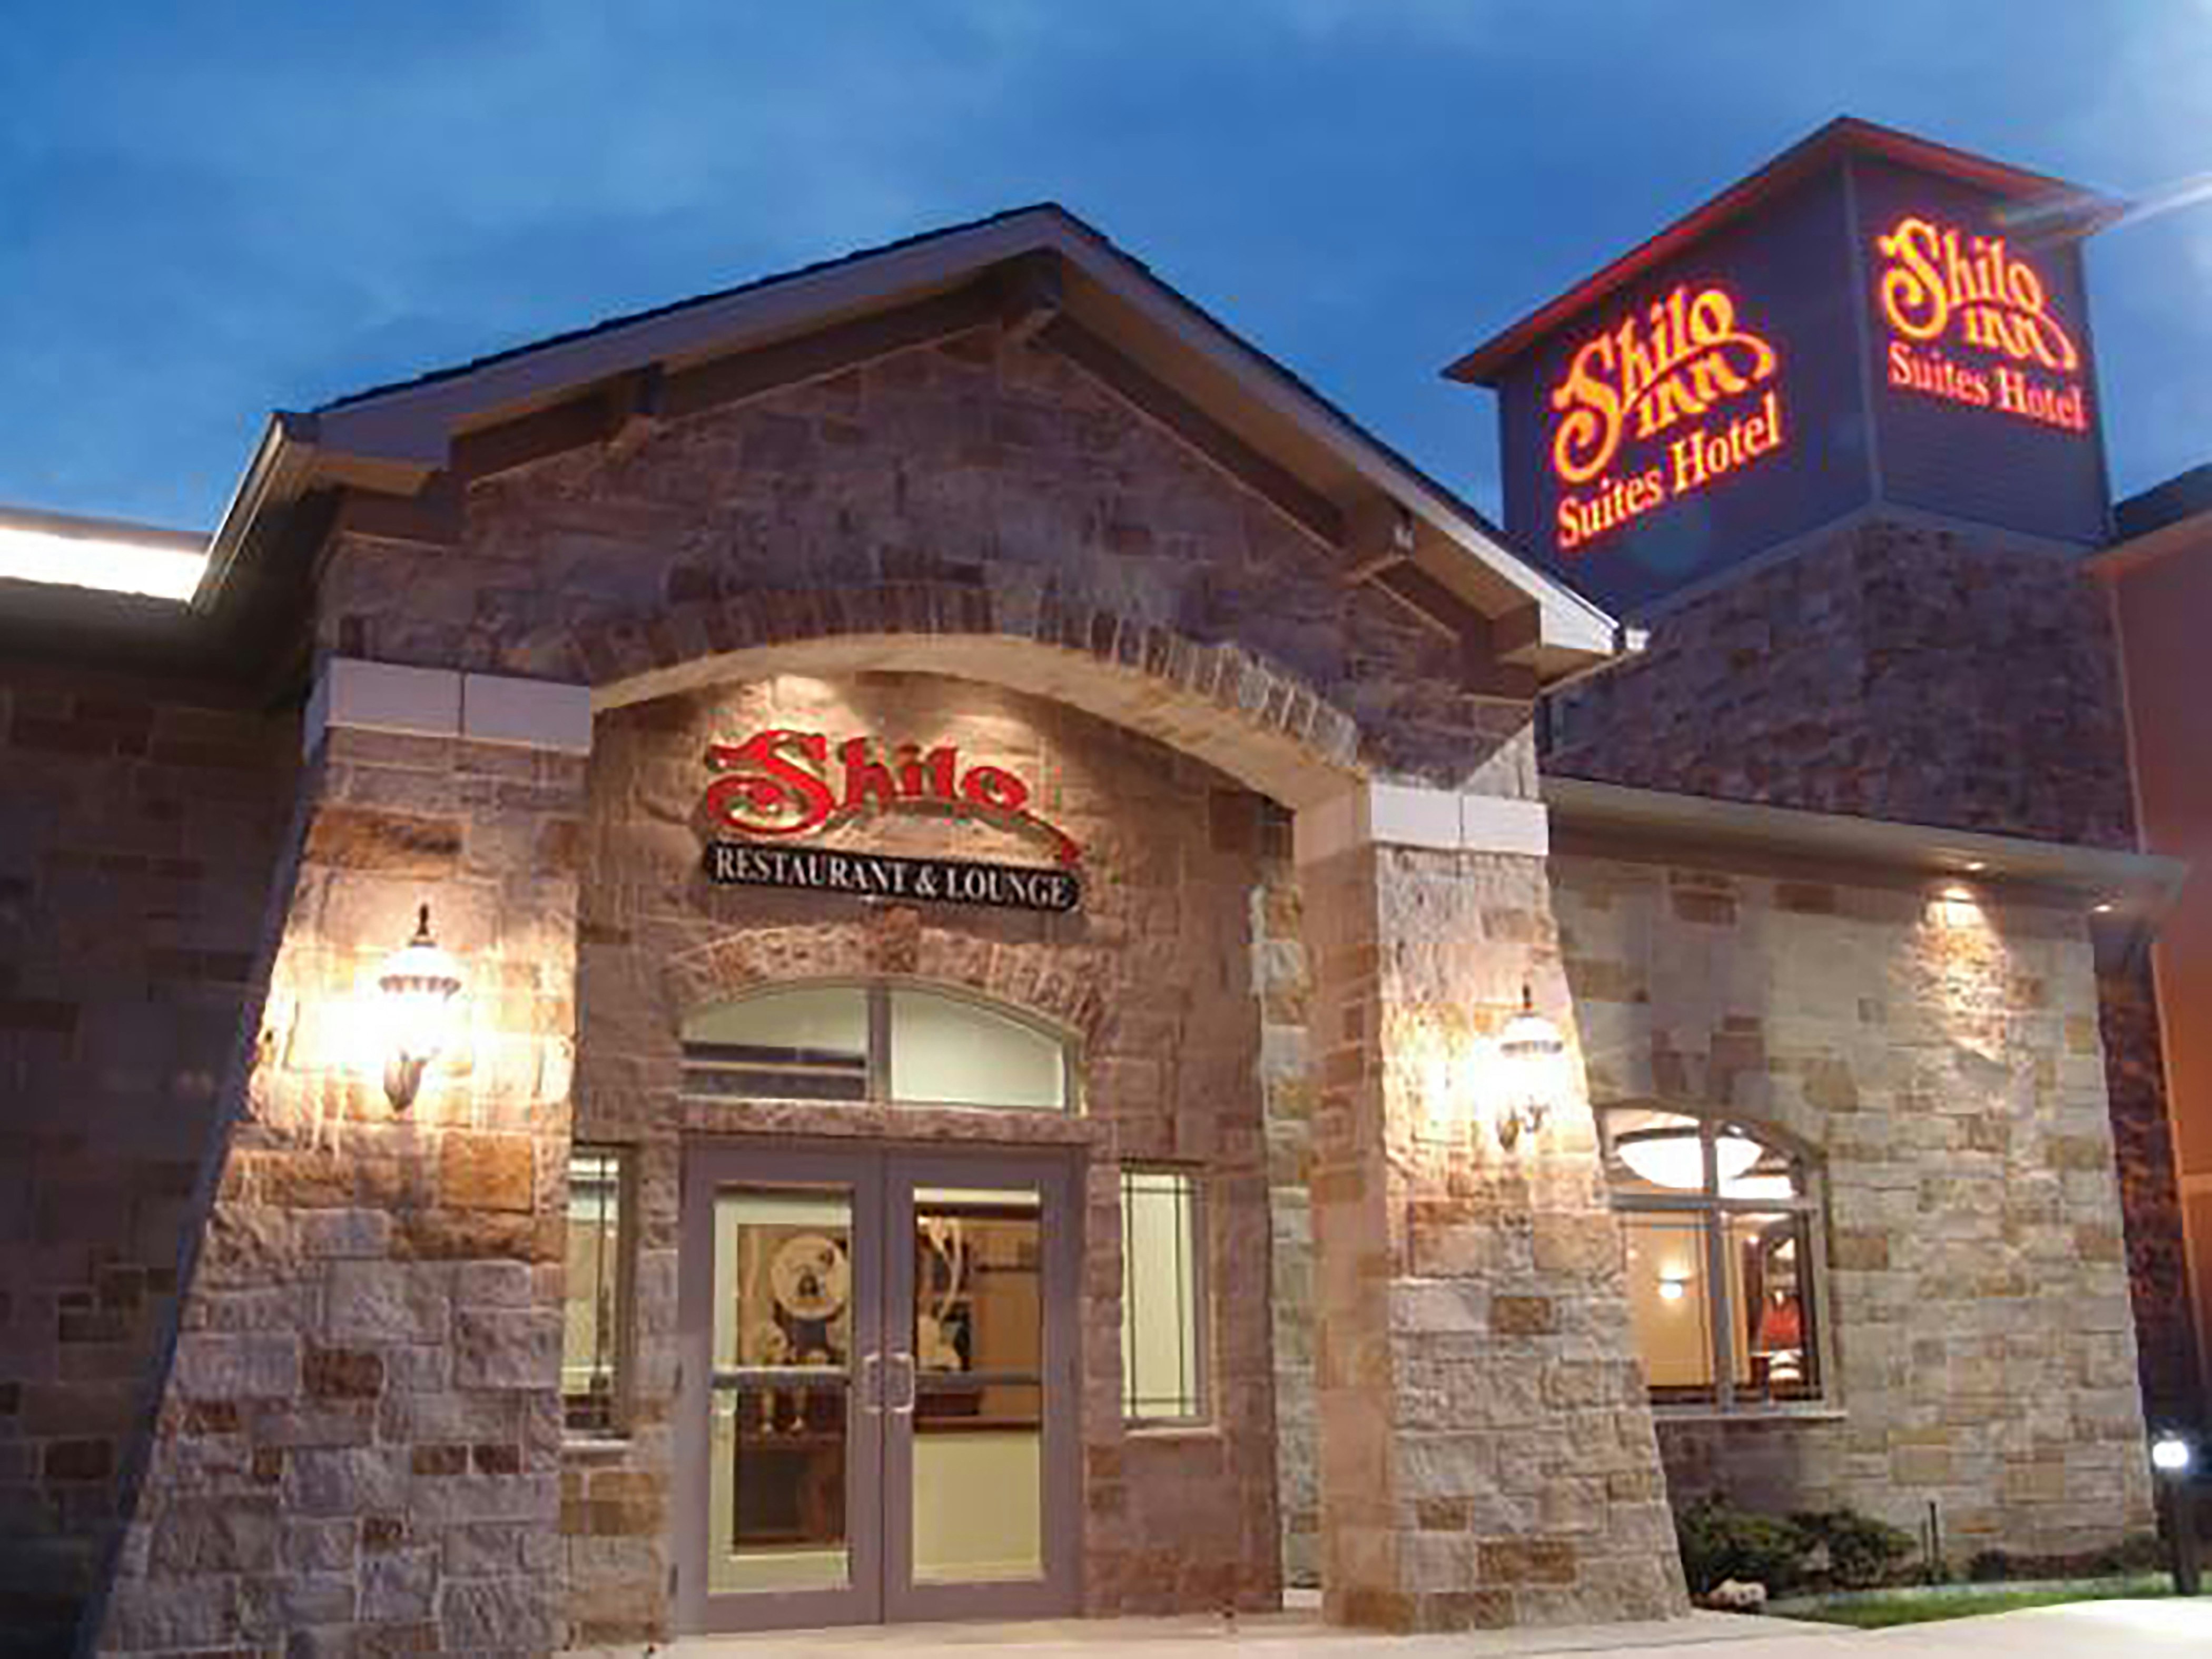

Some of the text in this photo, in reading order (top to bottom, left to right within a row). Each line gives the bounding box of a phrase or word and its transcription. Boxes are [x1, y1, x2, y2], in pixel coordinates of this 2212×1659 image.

[1879, 219, 2077, 369] Shilo
[1553, 287, 1775, 482] Shilo
[1888, 341, 2087, 429] Suites Hotel
[1558, 390, 1780, 548] Suites Hotel
[705, 729, 1080, 866] Shilo
[715, 847, 1069, 907] RESTAURANT & LOUNGE
